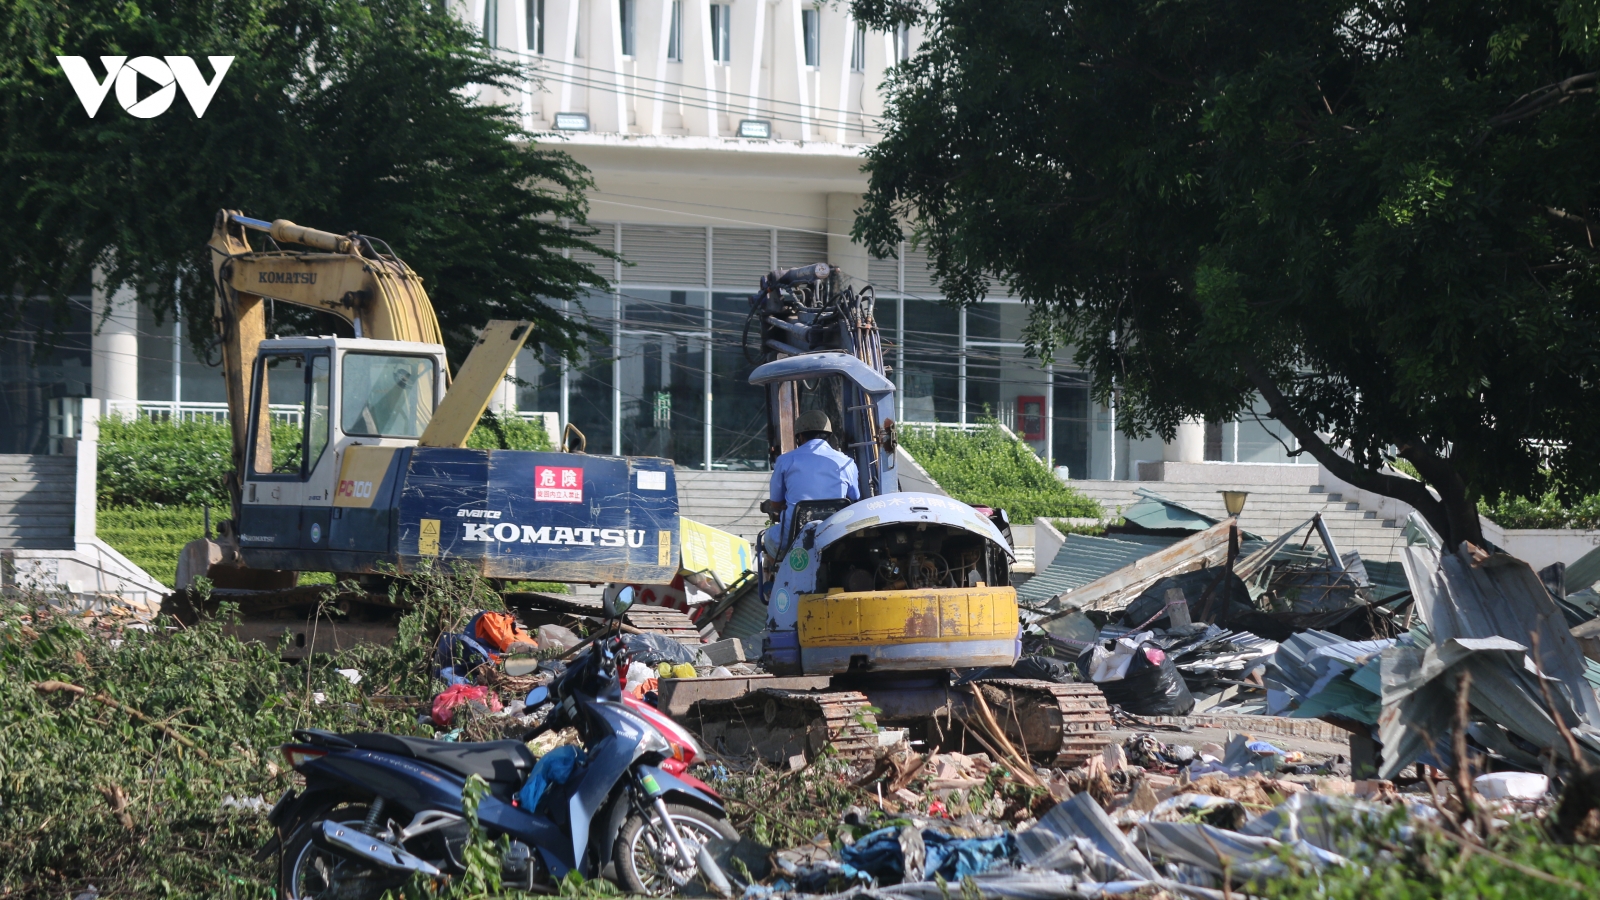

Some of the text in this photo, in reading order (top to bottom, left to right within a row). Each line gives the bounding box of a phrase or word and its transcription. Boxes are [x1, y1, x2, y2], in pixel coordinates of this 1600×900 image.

[258, 271, 317, 285] KOMATSU
[540, 468, 578, 488] 危険
[338, 480, 372, 498] PC100
[457, 508, 501, 519] avance
[462, 522, 646, 548] KOMATSU
